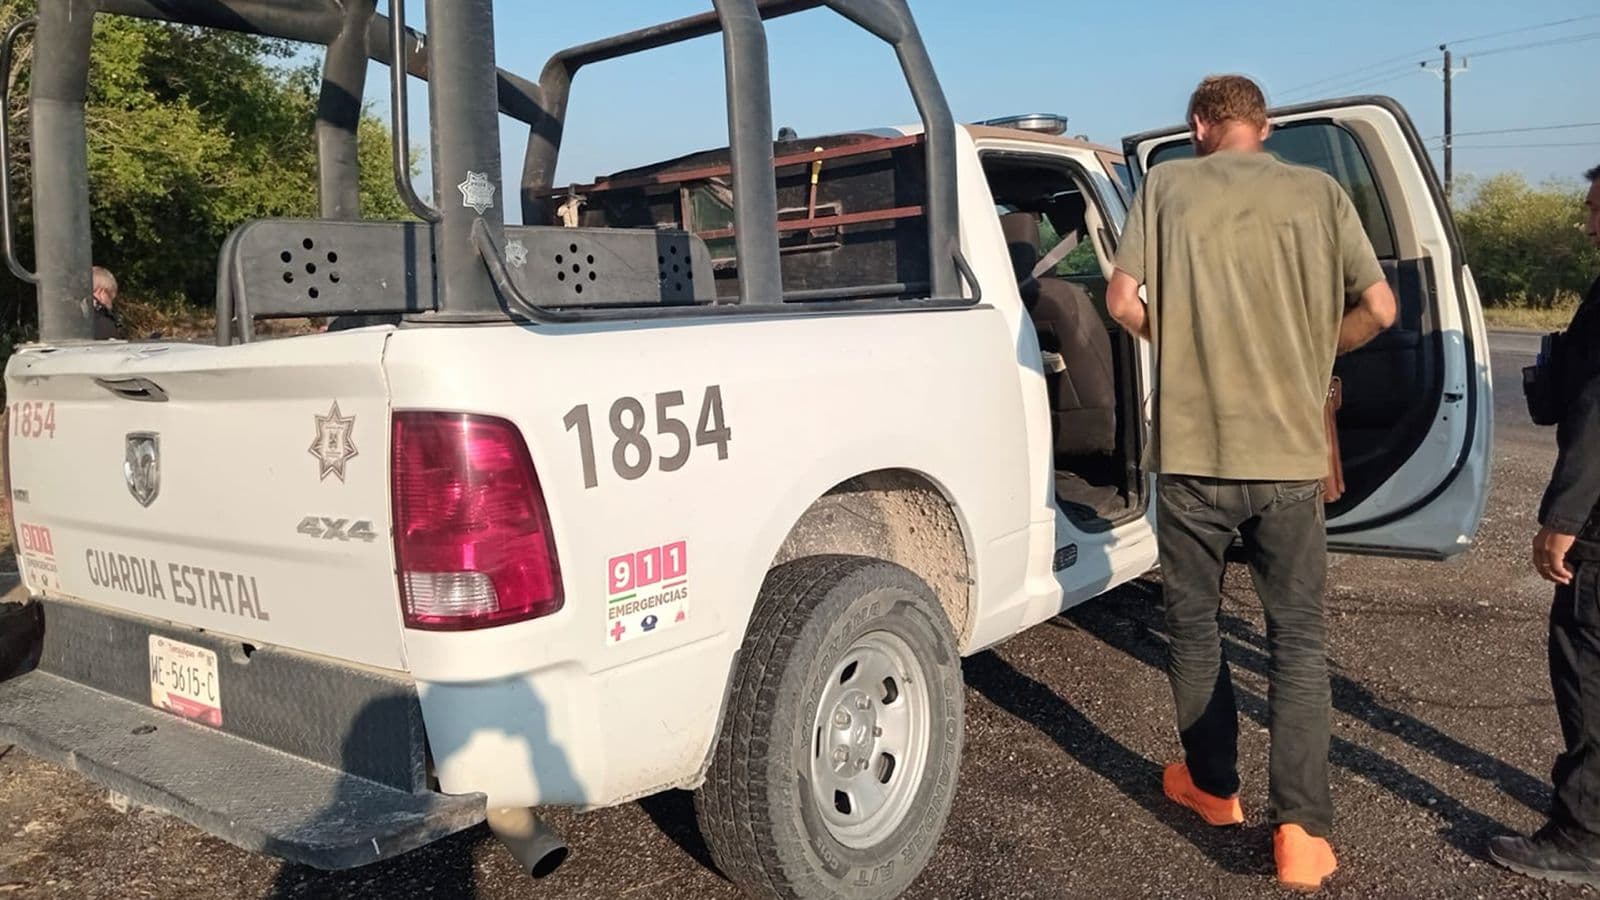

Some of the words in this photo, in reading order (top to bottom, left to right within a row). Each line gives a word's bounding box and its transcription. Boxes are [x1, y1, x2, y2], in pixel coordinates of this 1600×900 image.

[11, 402, 56, 438] 1854
[564, 385, 731, 489] 1854
[24, 526, 54, 553] 911
[86, 548, 165, 600] GUARDIA
[168, 562, 269, 621] ESTATAL
[612, 546, 682, 588] 911
[608, 587, 688, 620] EMERGENCIAS
